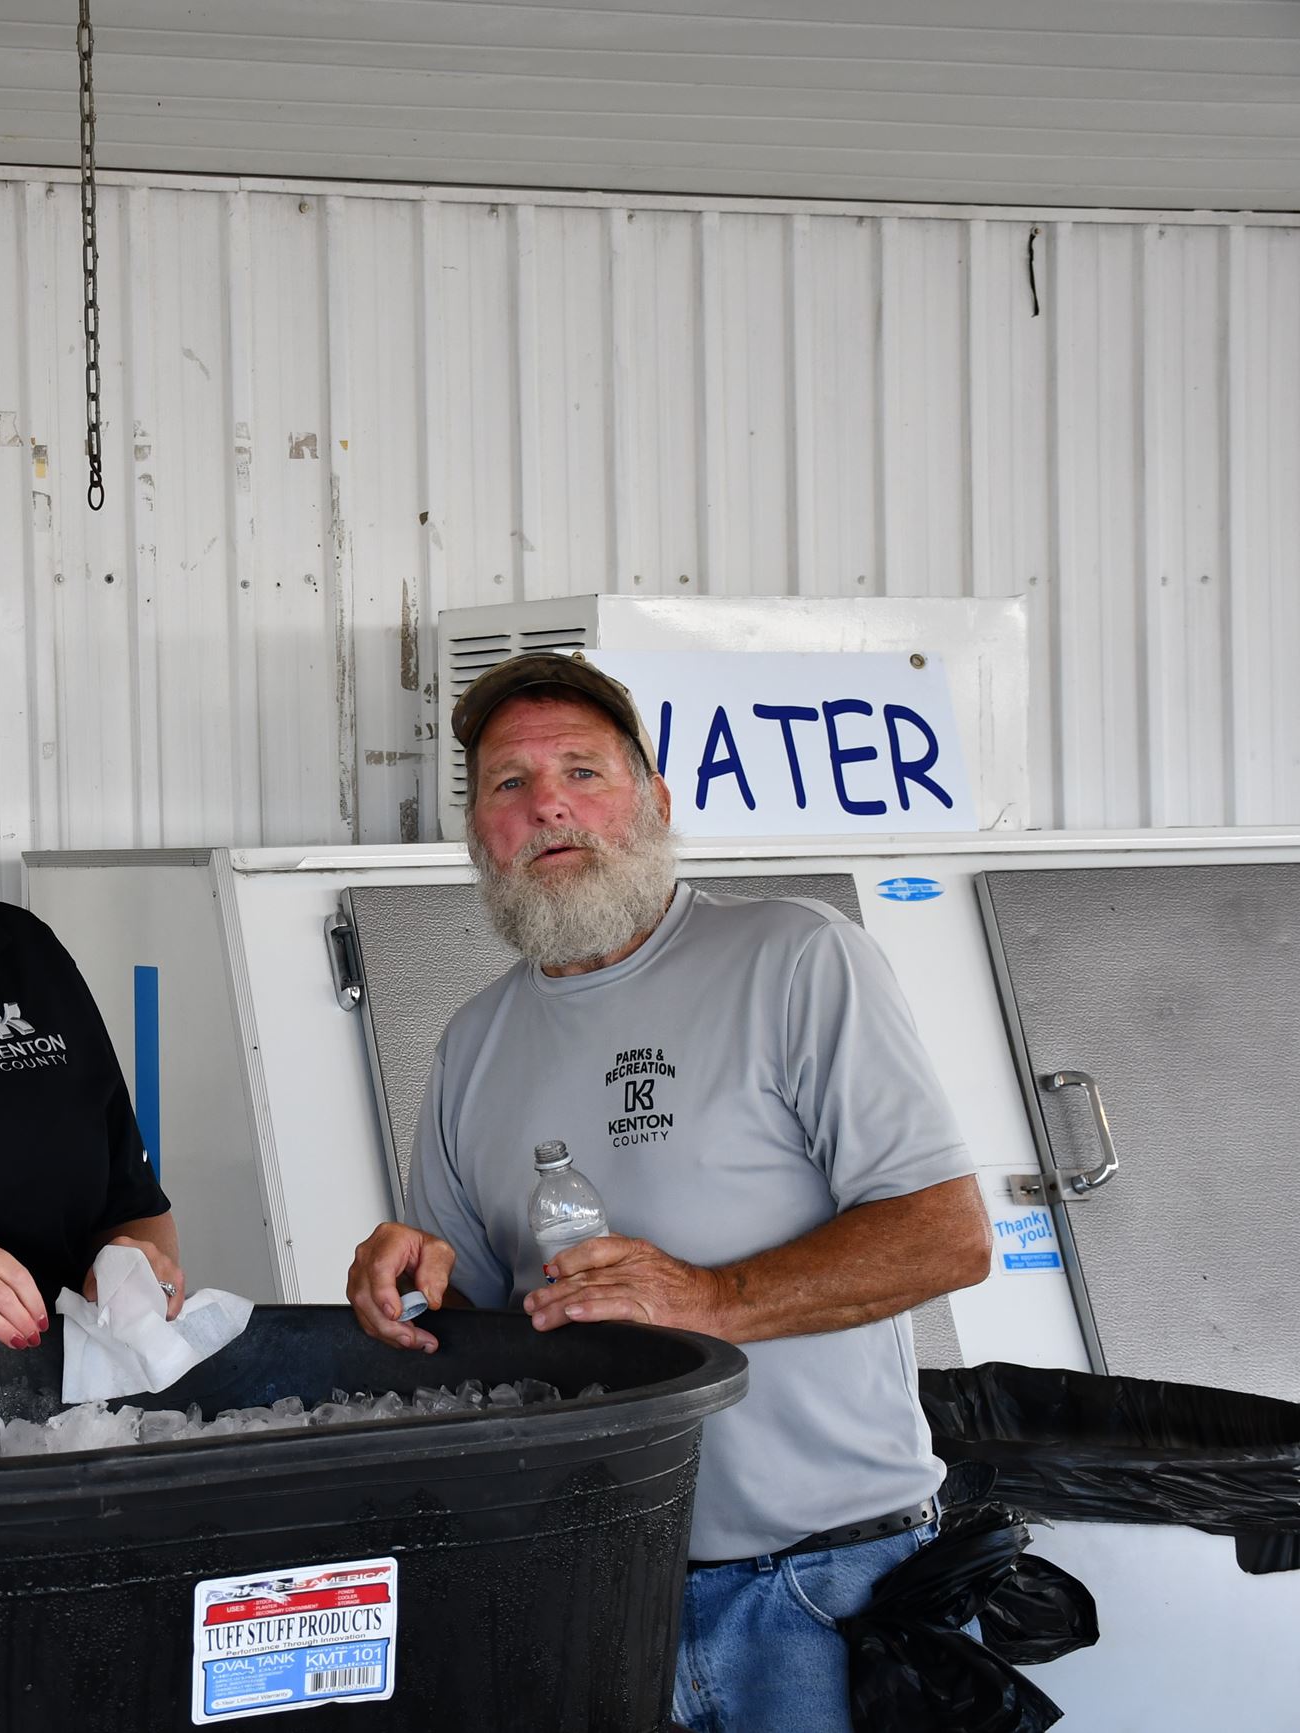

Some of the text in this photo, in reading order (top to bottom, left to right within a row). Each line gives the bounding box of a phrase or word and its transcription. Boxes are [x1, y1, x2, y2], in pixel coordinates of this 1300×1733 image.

[0, 1054, 67, 1072] COUNTY
[615, 1048, 664, 1066] PARKS &
[605, 1061, 676, 1087] RECREATION
[608, 1113, 673, 1135] KENTON
[612, 1130, 669, 1148] COUNTY
[994, 1211, 1042, 1237] Thank
[1018, 1212, 1052, 1248] you!
[308, 1570, 390, 1588] AMERICA
[205, 1607, 382, 1652] TUFF STUFF PRODUCTS
[226, 1633, 366, 1656] Performance Through Innovation
[213, 1652, 295, 1673] OVAL TANK
[306, 1646, 382, 1668] KMT 101
